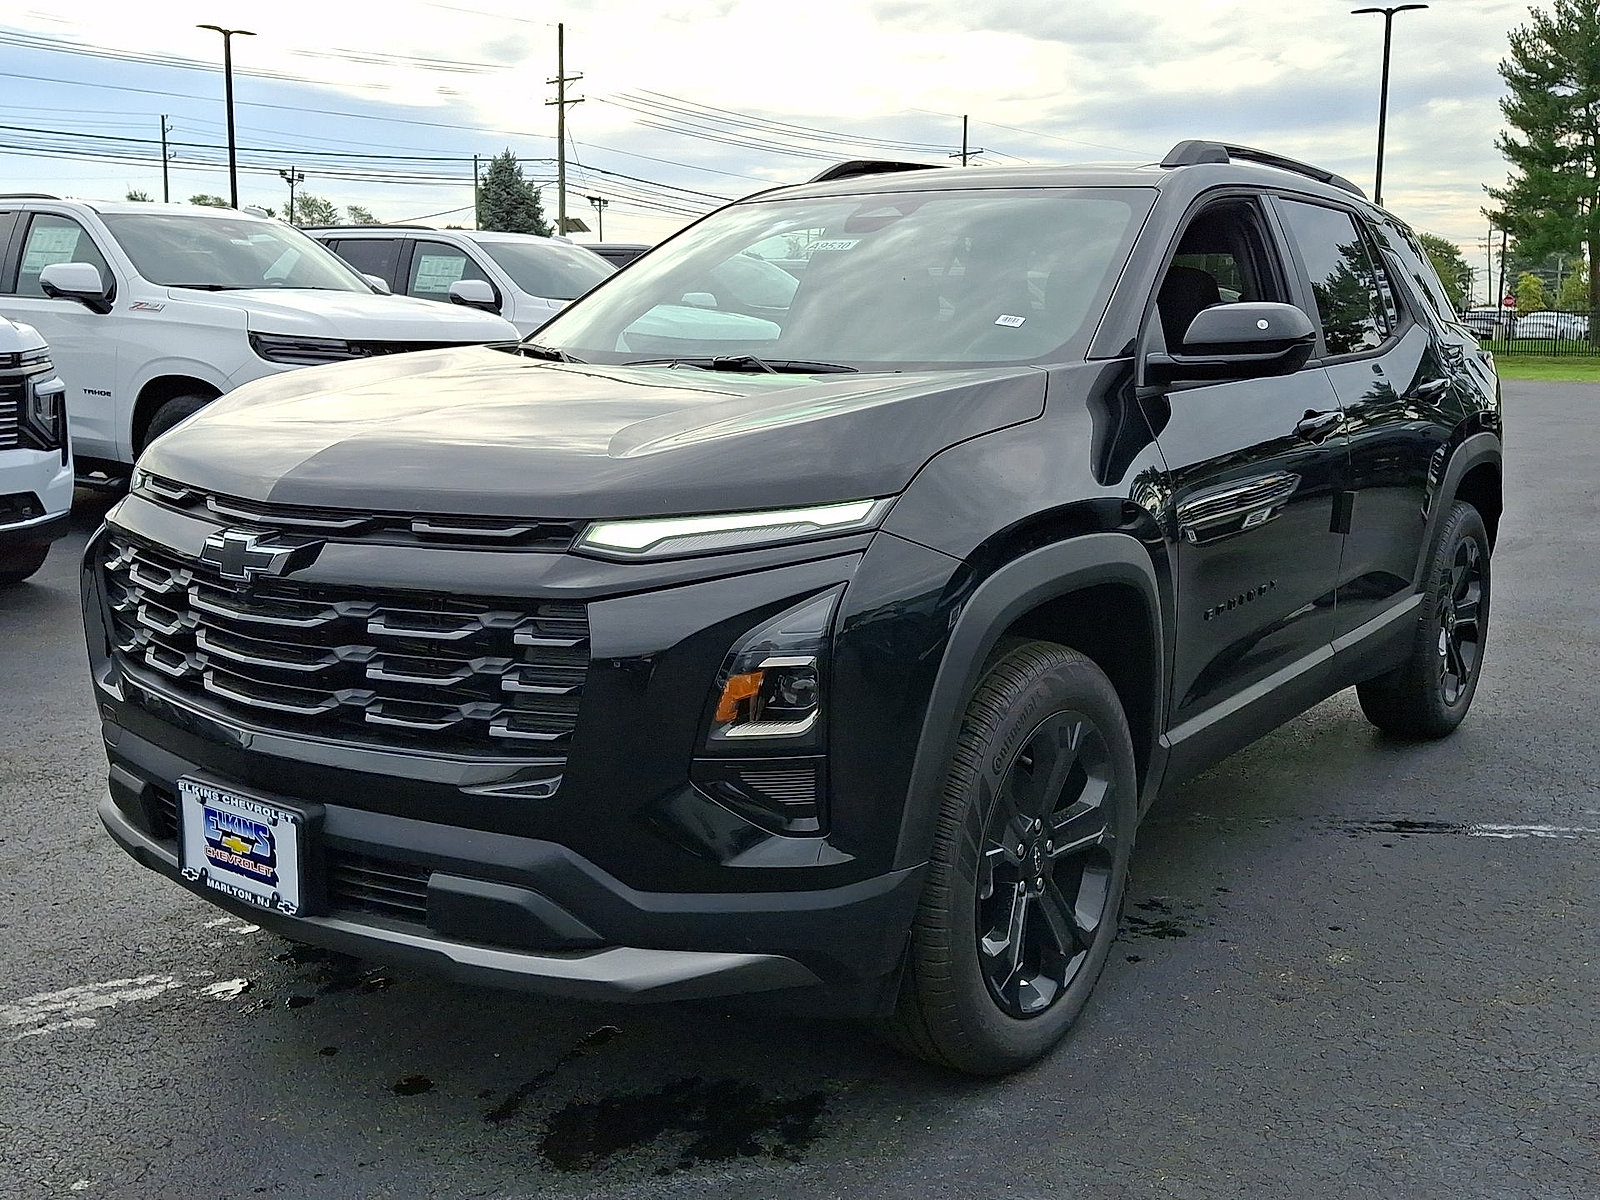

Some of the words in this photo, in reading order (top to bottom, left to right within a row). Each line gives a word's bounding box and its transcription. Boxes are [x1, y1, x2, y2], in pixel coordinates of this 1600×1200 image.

[83, 388, 111, 397] TAHOE
[178, 782, 219, 801] ELKINS
[222, 794, 294, 823] CHEVROLET
[203, 806, 270, 857] ELKINS
[204, 845, 274, 877] CHEVROLET
[206, 878, 255, 904] MARLTON,
[257, 896, 270, 907] NJ
